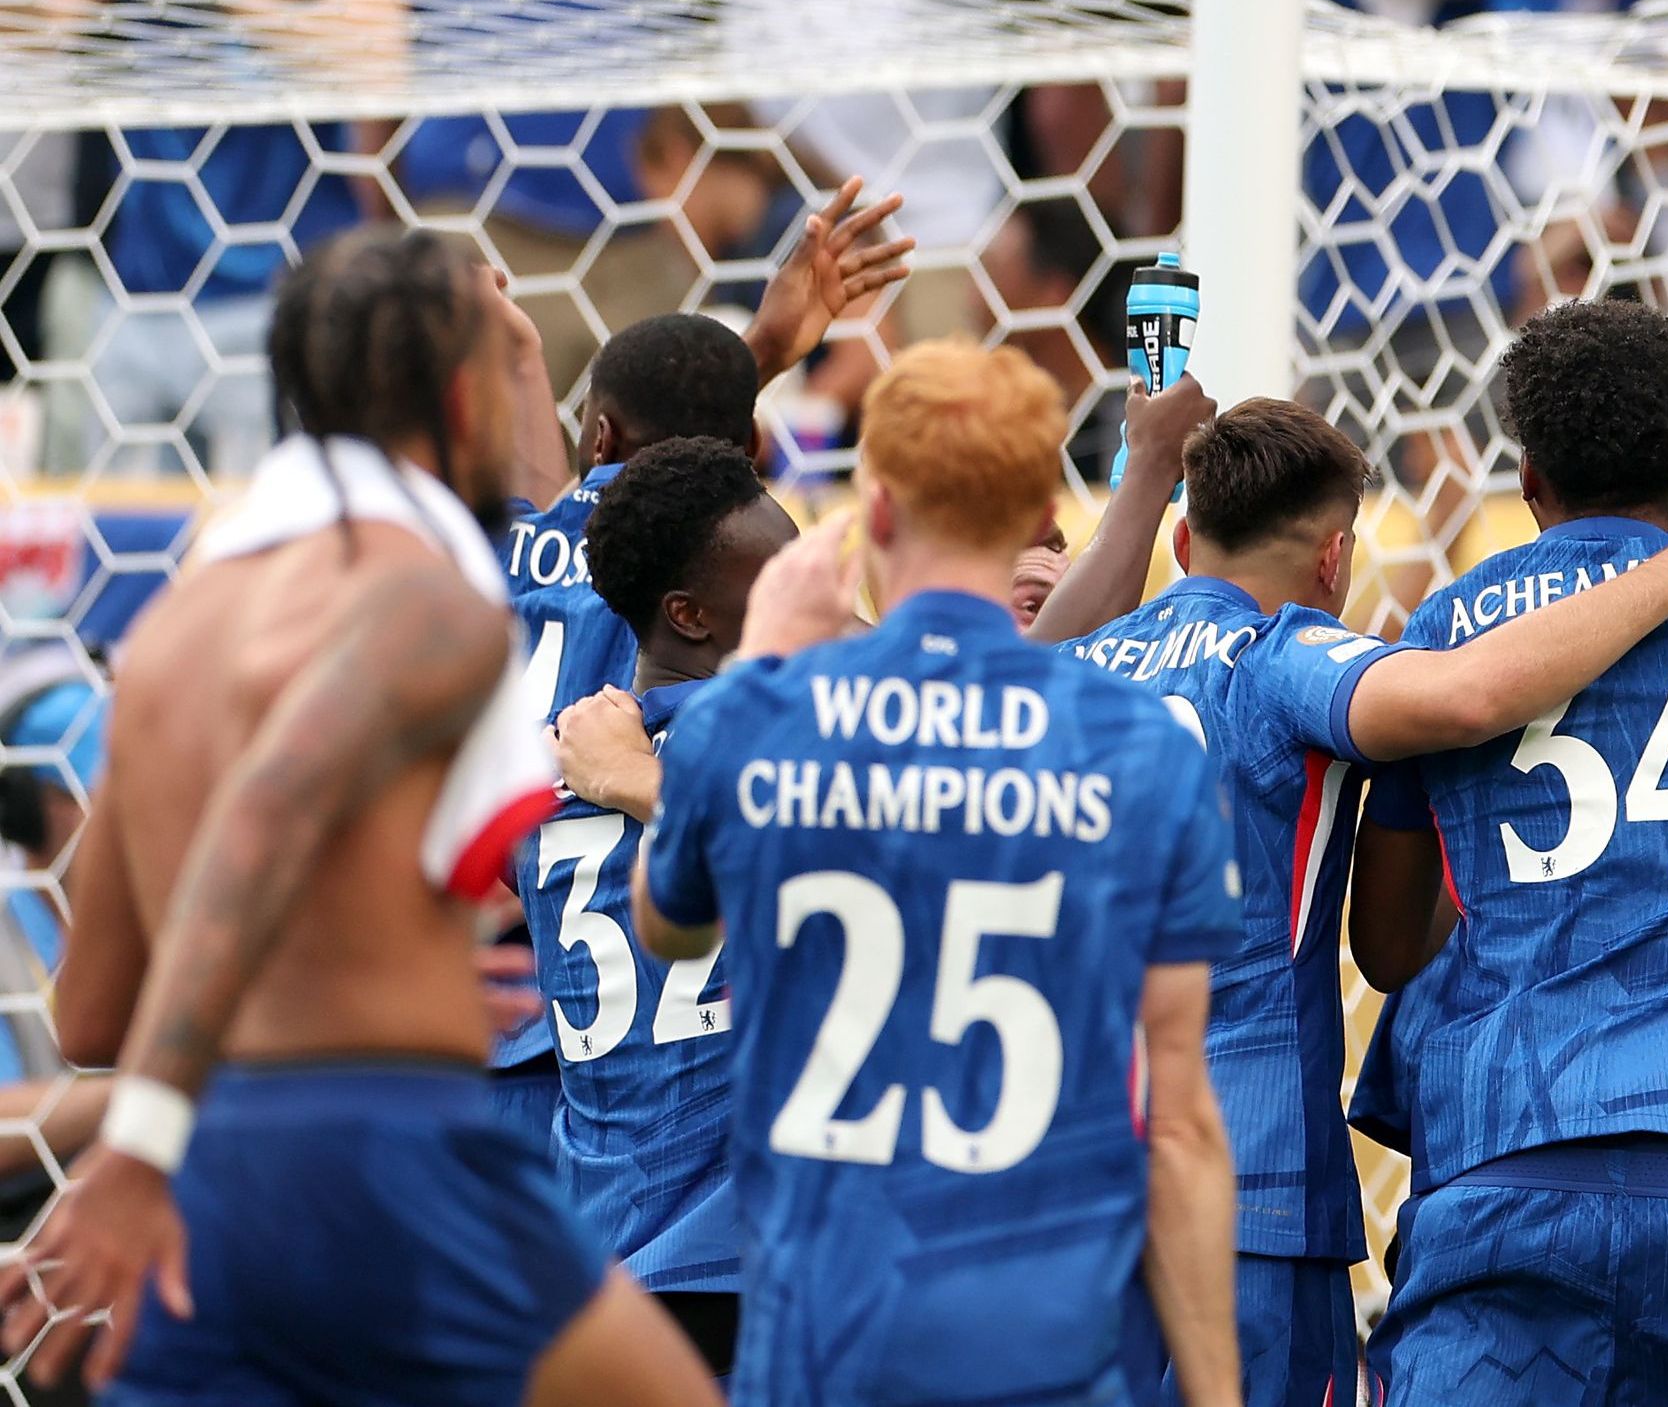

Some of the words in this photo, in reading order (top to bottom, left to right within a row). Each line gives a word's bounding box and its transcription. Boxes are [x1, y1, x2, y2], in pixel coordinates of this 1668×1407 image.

[573, 489, 599, 504] CFC
[509, 520, 593, 587] TOS
[1449, 557, 1652, 645] ACHEAM
[811, 675, 1049, 750] WORLD
[737, 759, 1112, 842] CHAMPIONS
[768, 868, 1067, 1175] 25
